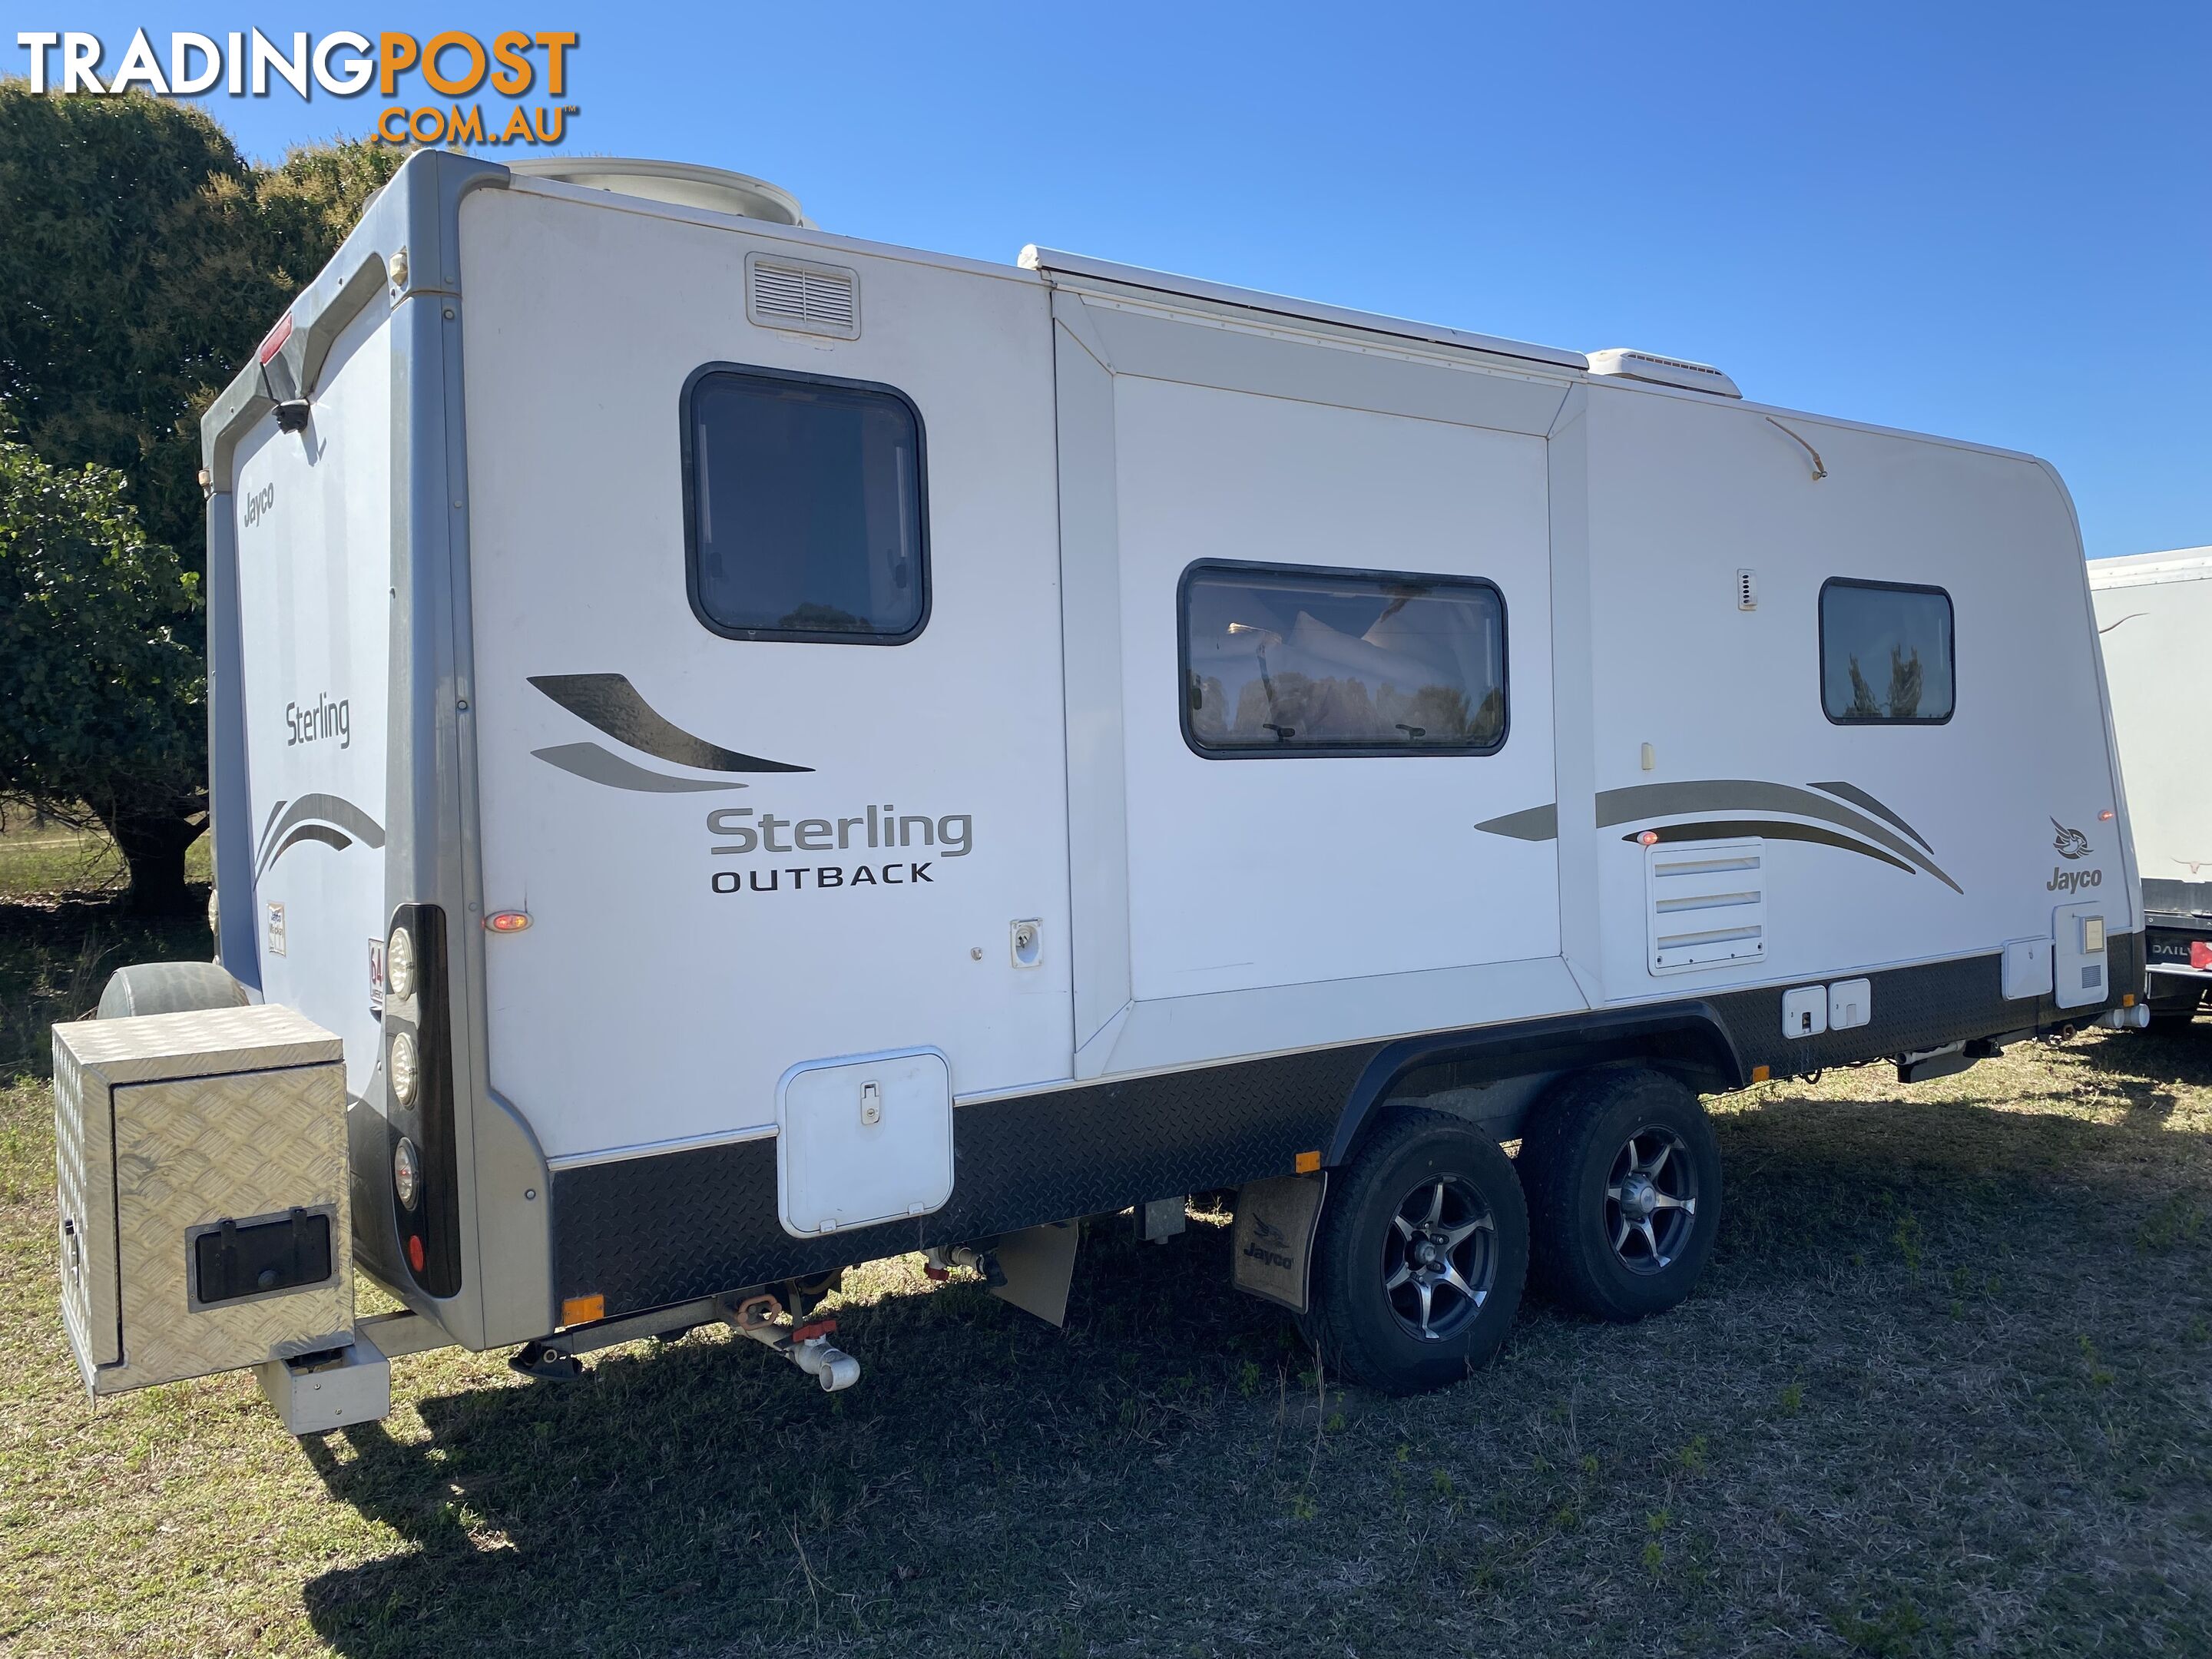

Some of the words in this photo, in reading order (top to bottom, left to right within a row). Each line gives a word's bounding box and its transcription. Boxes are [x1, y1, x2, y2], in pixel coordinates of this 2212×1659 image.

[244, 482, 274, 528] Jayco
[286, 691, 349, 750] Sterling
[707, 804, 972, 857] Sterling
[711, 862, 934, 893] OUTBACK
[2046, 866, 2102, 894] Jayco
[1243, 1242, 1292, 1270] Jayco
